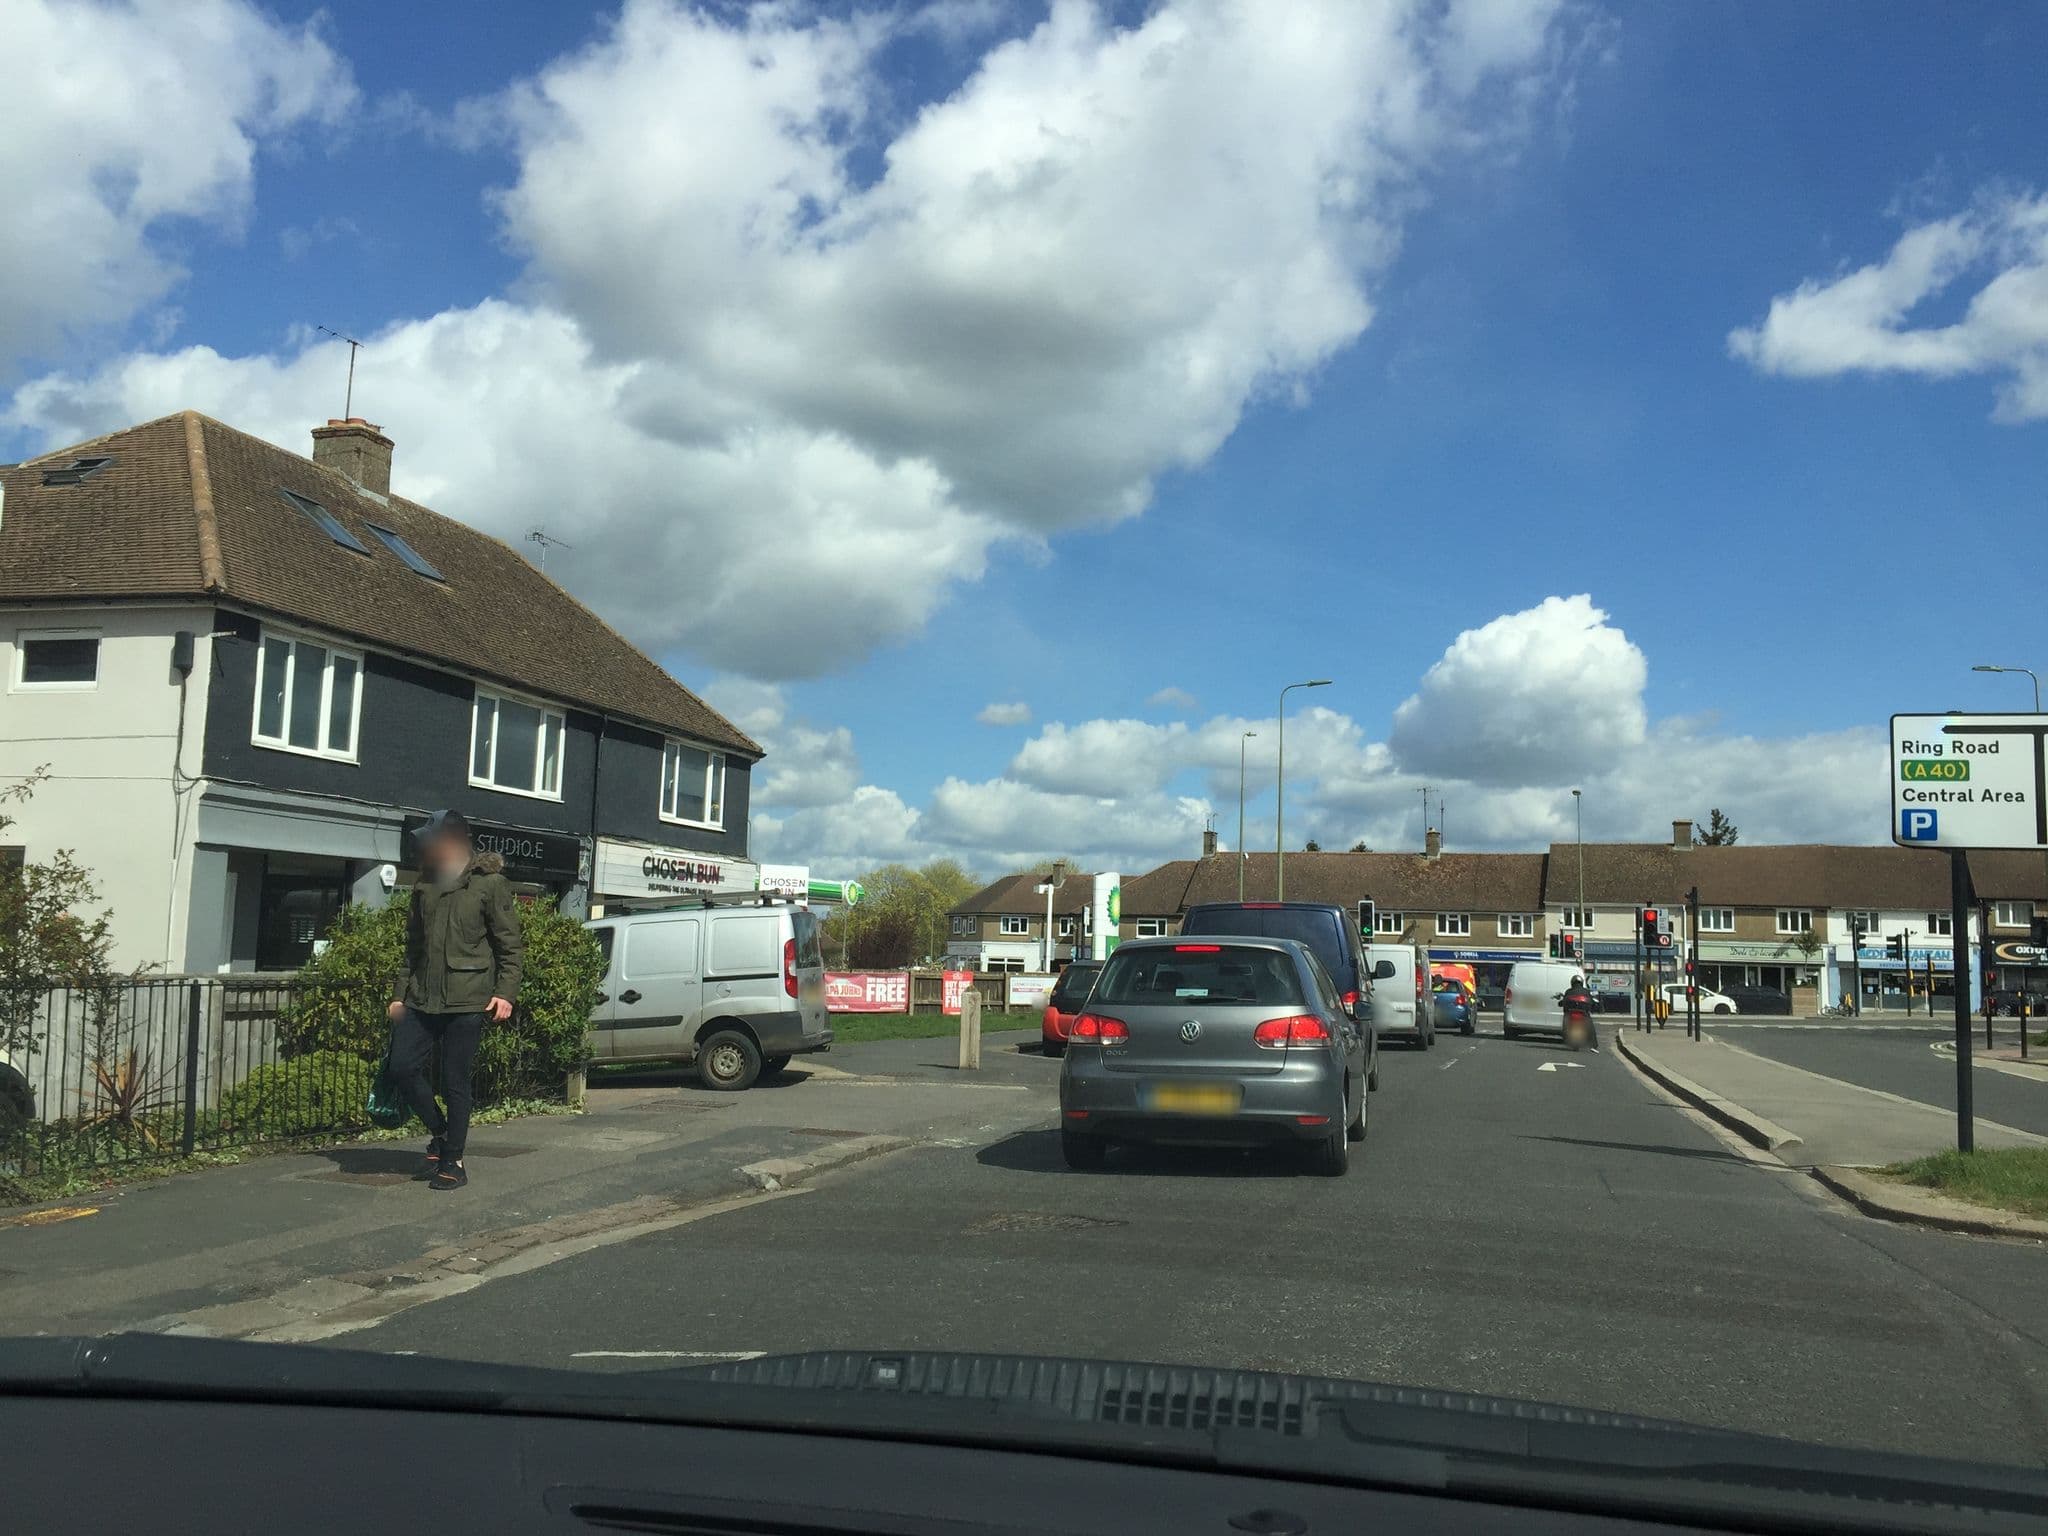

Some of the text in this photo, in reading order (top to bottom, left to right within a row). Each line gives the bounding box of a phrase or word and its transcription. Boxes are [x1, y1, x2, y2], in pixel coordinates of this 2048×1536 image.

[1902, 740, 2000, 756] Ring Road
[1903, 761, 1967, 780] (A40)
[1902, 788, 2026, 803] Central Area
[1910, 812, 1933, 838] P
[642, 855, 721, 885] CHOSEN BUN
[763, 877, 806, 887] CHOSEN
[866, 983, 906, 1002] FREE
